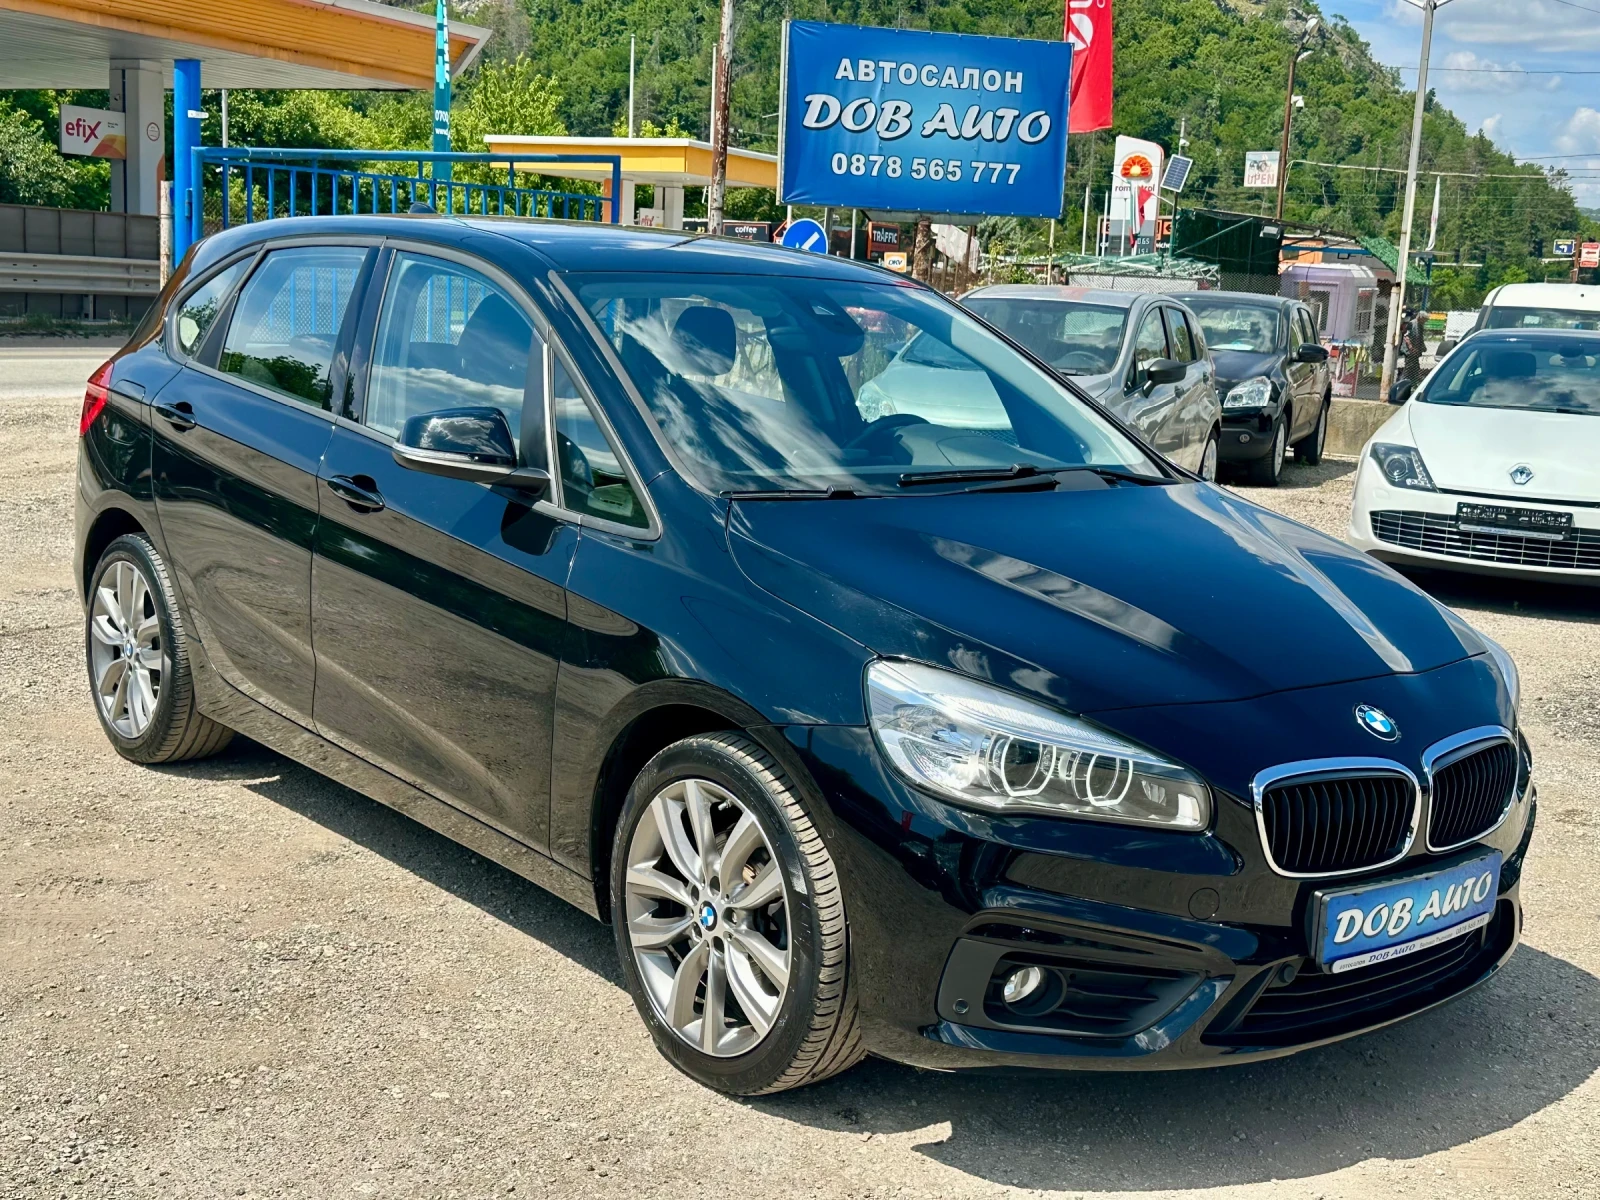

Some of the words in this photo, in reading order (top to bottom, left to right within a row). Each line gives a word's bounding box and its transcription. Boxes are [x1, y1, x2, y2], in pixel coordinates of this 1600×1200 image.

[834, 58, 1023, 94] АВТОСАЛОН
[65, 117, 102, 144] efix
[801, 93, 913, 140] DOB
[920, 102, 1052, 144] AUTO
[831, 152, 903, 179] 0878
[910, 157, 963, 182] 565
[970, 161, 1022, 186] 777
[734, 225, 758, 234] coffee
[872, 227, 898, 244] TRAFFIC
[1333, 897, 1415, 944] DOB
[1416, 870, 1493, 926] AUTO
[1369, 951, 1390, 963] DOB
